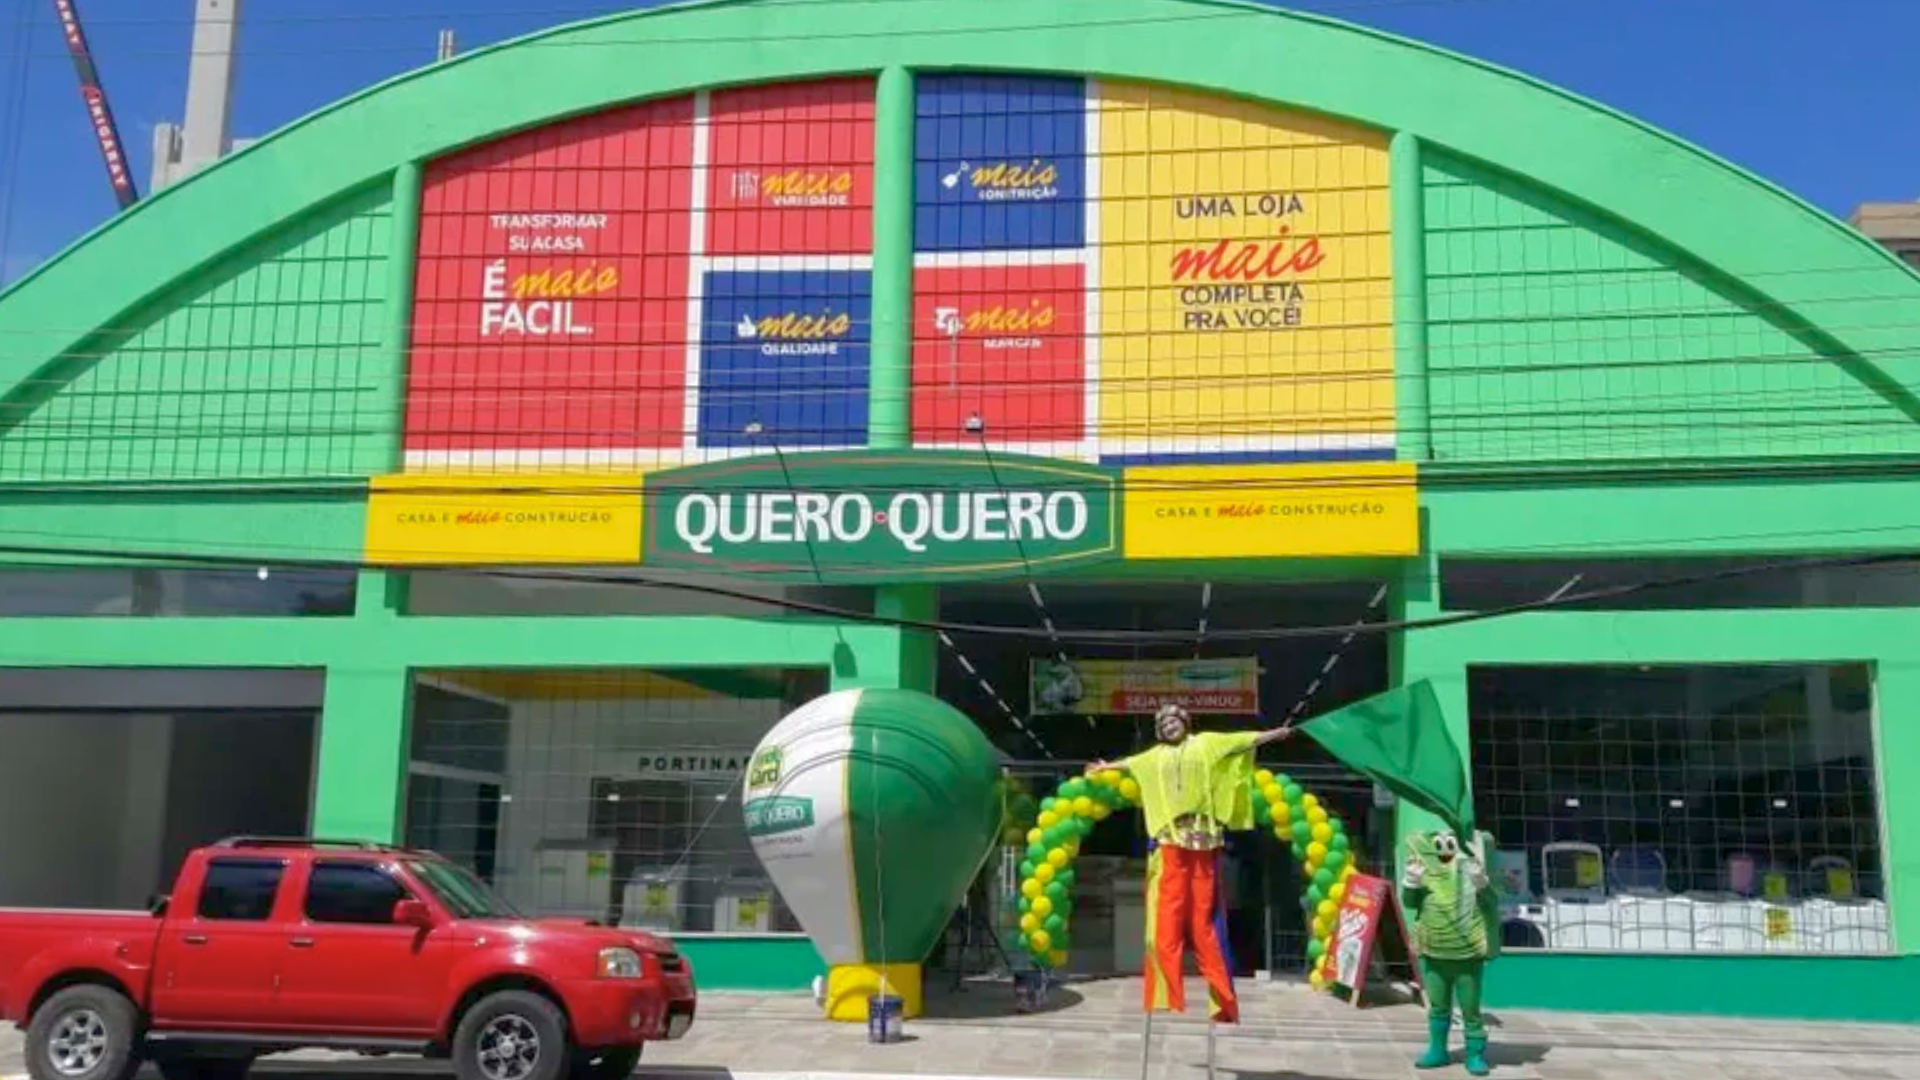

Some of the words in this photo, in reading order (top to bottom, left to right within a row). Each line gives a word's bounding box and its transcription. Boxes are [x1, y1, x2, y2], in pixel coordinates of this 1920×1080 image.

[970, 159, 1058, 188] mais
[1176, 195, 1236, 219] UMA
[1244, 193, 1303, 217] LOJA
[490, 213, 607, 229] TRANSFORMAR
[1170, 225, 1326, 281] mais
[483, 258, 506, 299] É
[511, 259, 618, 300] mais
[1180, 282, 1304, 306] COMPLETA
[757, 307, 849, 338] mais
[966, 299, 1053, 331] mais
[1184, 310, 1229, 330] PRA
[397, 512, 436, 525] CASA
[1155, 506, 1197, 518] CASA
[1204, 507, 1212, 518] E
[1269, 501, 1385, 517] CONSTRUÇÃO
